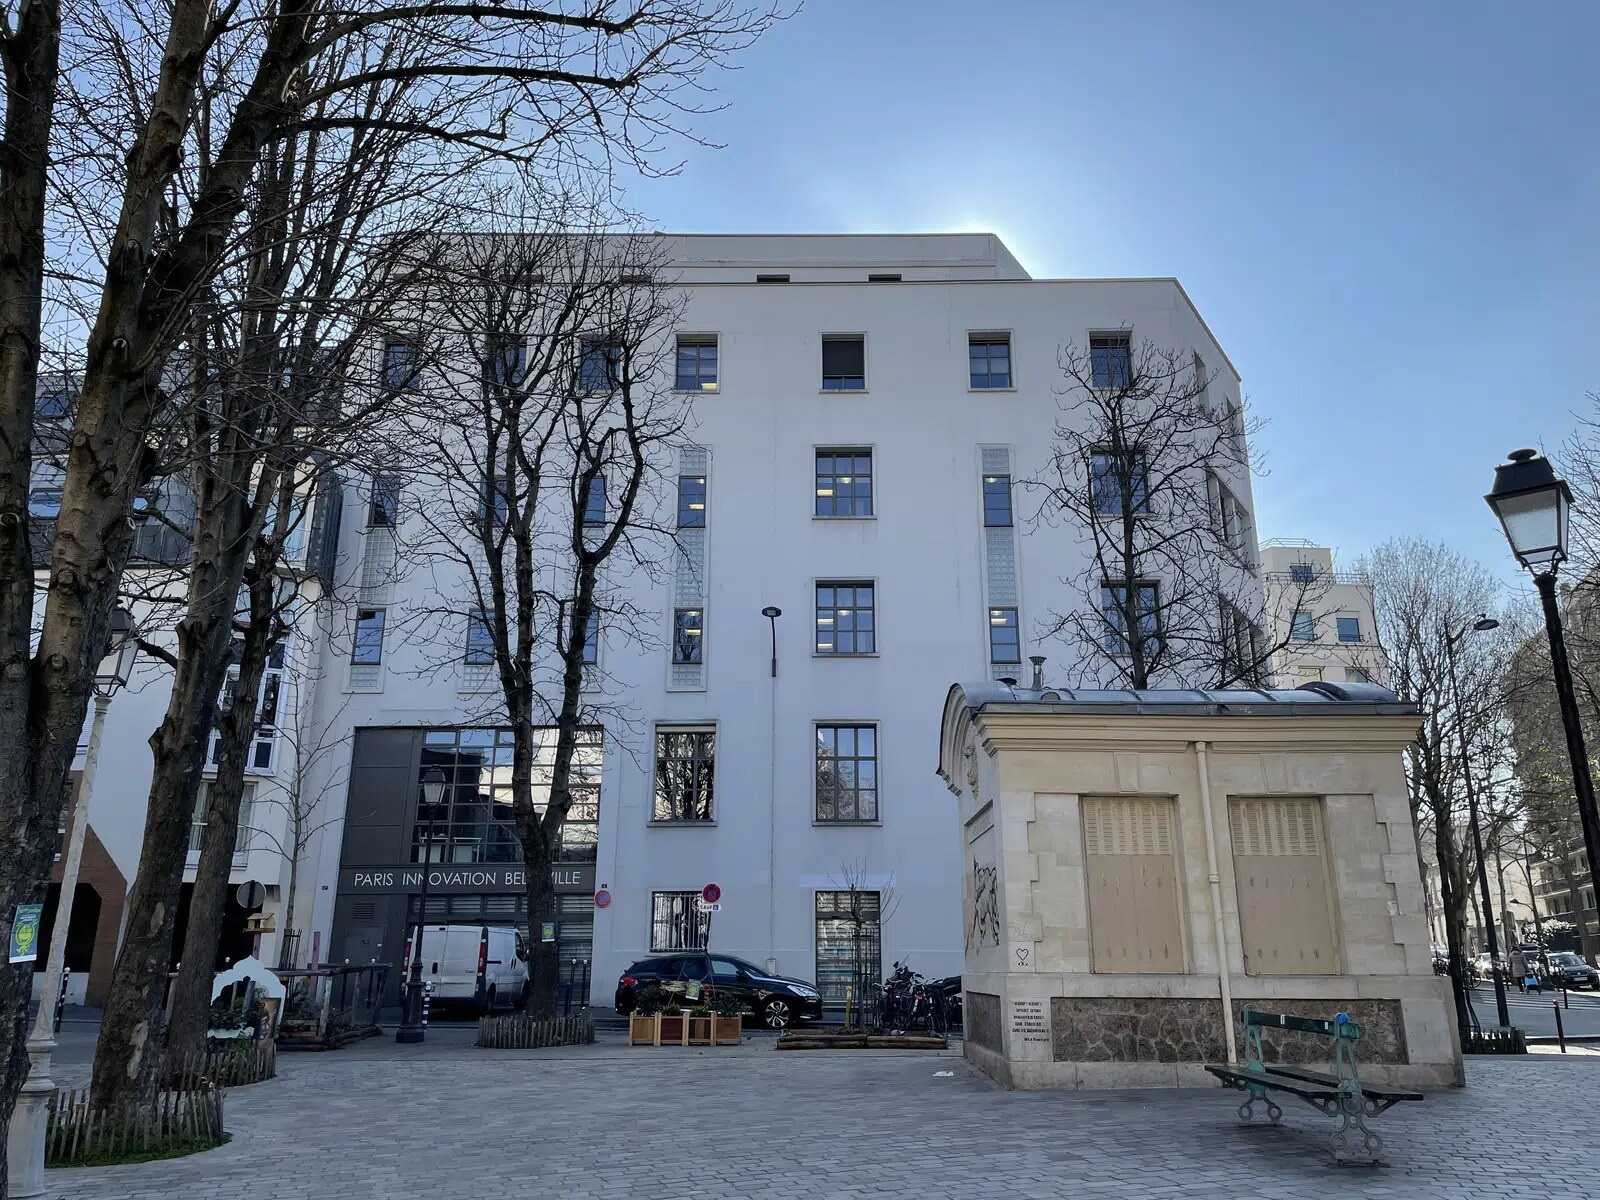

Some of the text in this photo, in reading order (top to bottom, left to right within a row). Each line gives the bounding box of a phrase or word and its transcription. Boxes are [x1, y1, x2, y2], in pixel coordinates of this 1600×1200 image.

[354, 871, 581, 886] PARIS INNOVATION BELILLE
